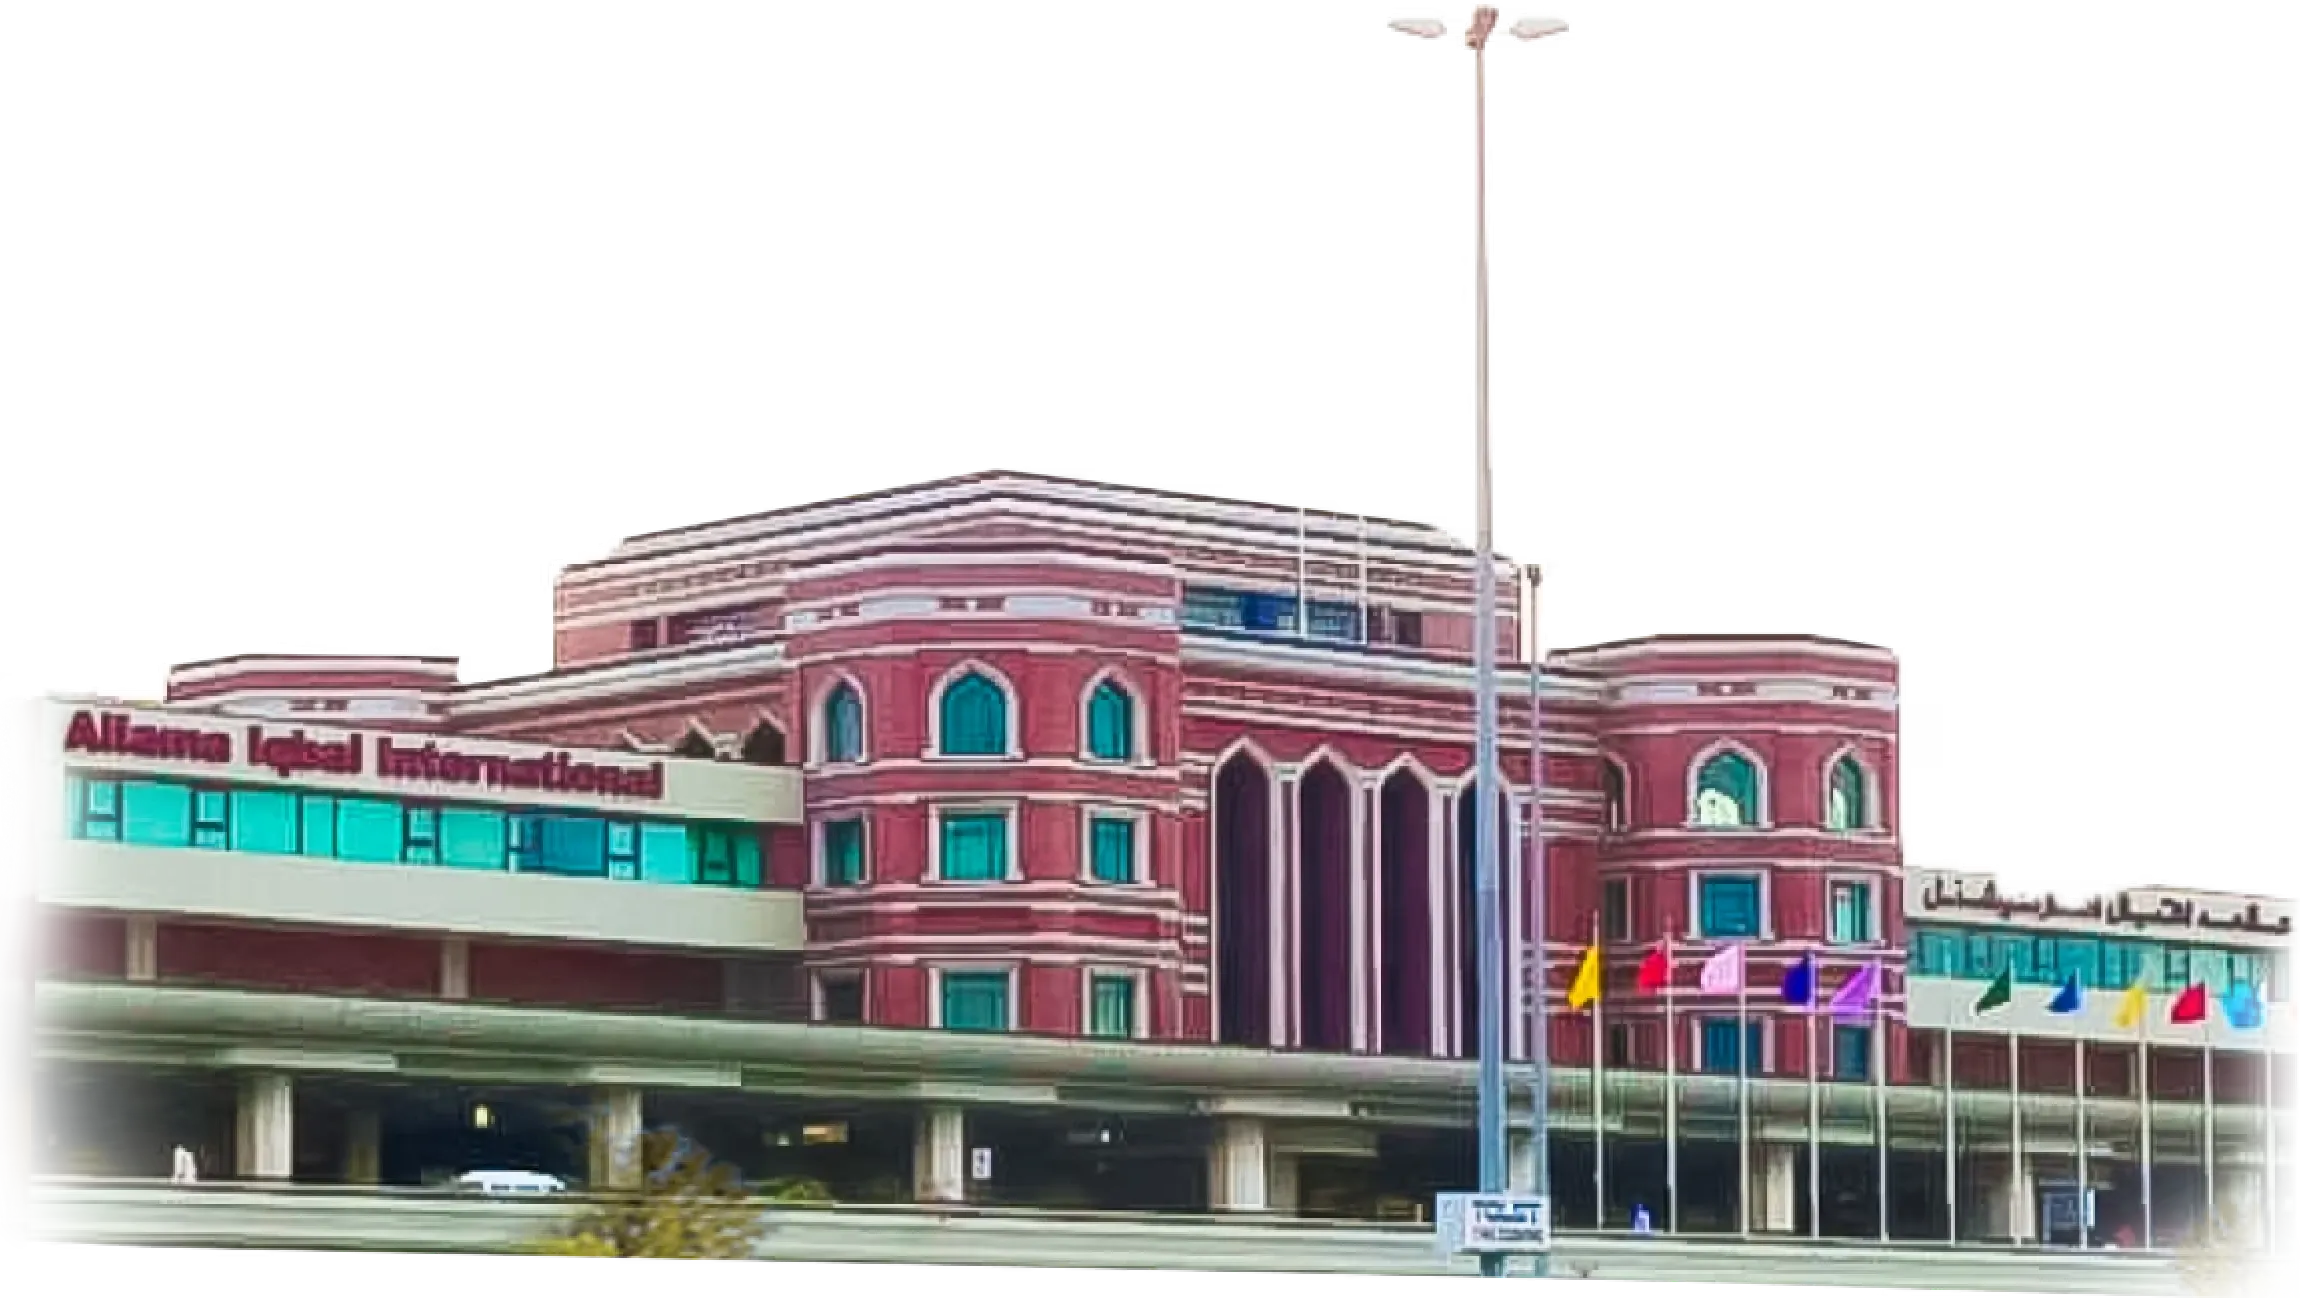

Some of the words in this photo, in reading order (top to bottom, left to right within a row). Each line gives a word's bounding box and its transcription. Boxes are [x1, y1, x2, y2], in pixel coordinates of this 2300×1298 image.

[65, 711, 231, 764] Allama
[247, 726, 363, 777] Iqbal
[377, 737, 664, 799] International
